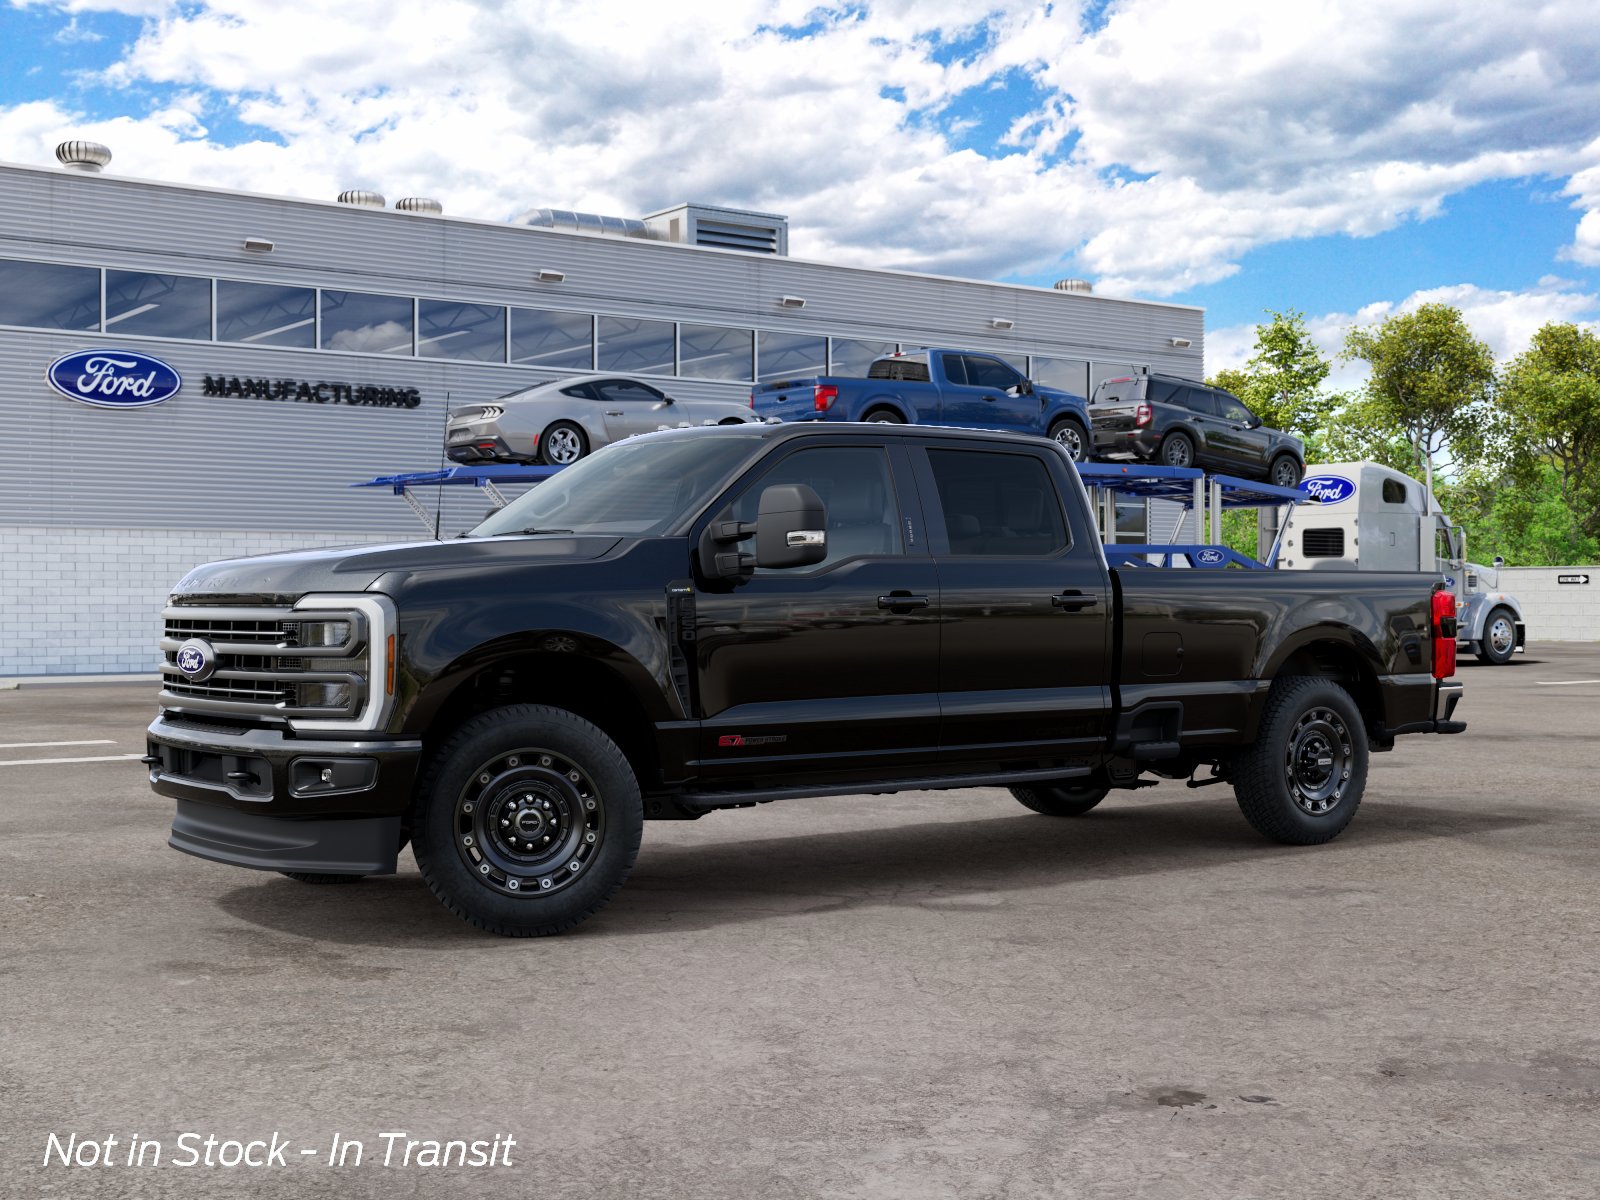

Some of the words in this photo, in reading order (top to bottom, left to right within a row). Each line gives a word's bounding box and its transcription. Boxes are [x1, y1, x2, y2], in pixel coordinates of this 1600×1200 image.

[76, 356, 157, 398] Ford
[203, 374, 421, 409] MANUFACTURING
[1306, 480, 1343, 500] Ford
[1201, 550, 1219, 561] Ford
[181, 650, 200, 669] Ford
